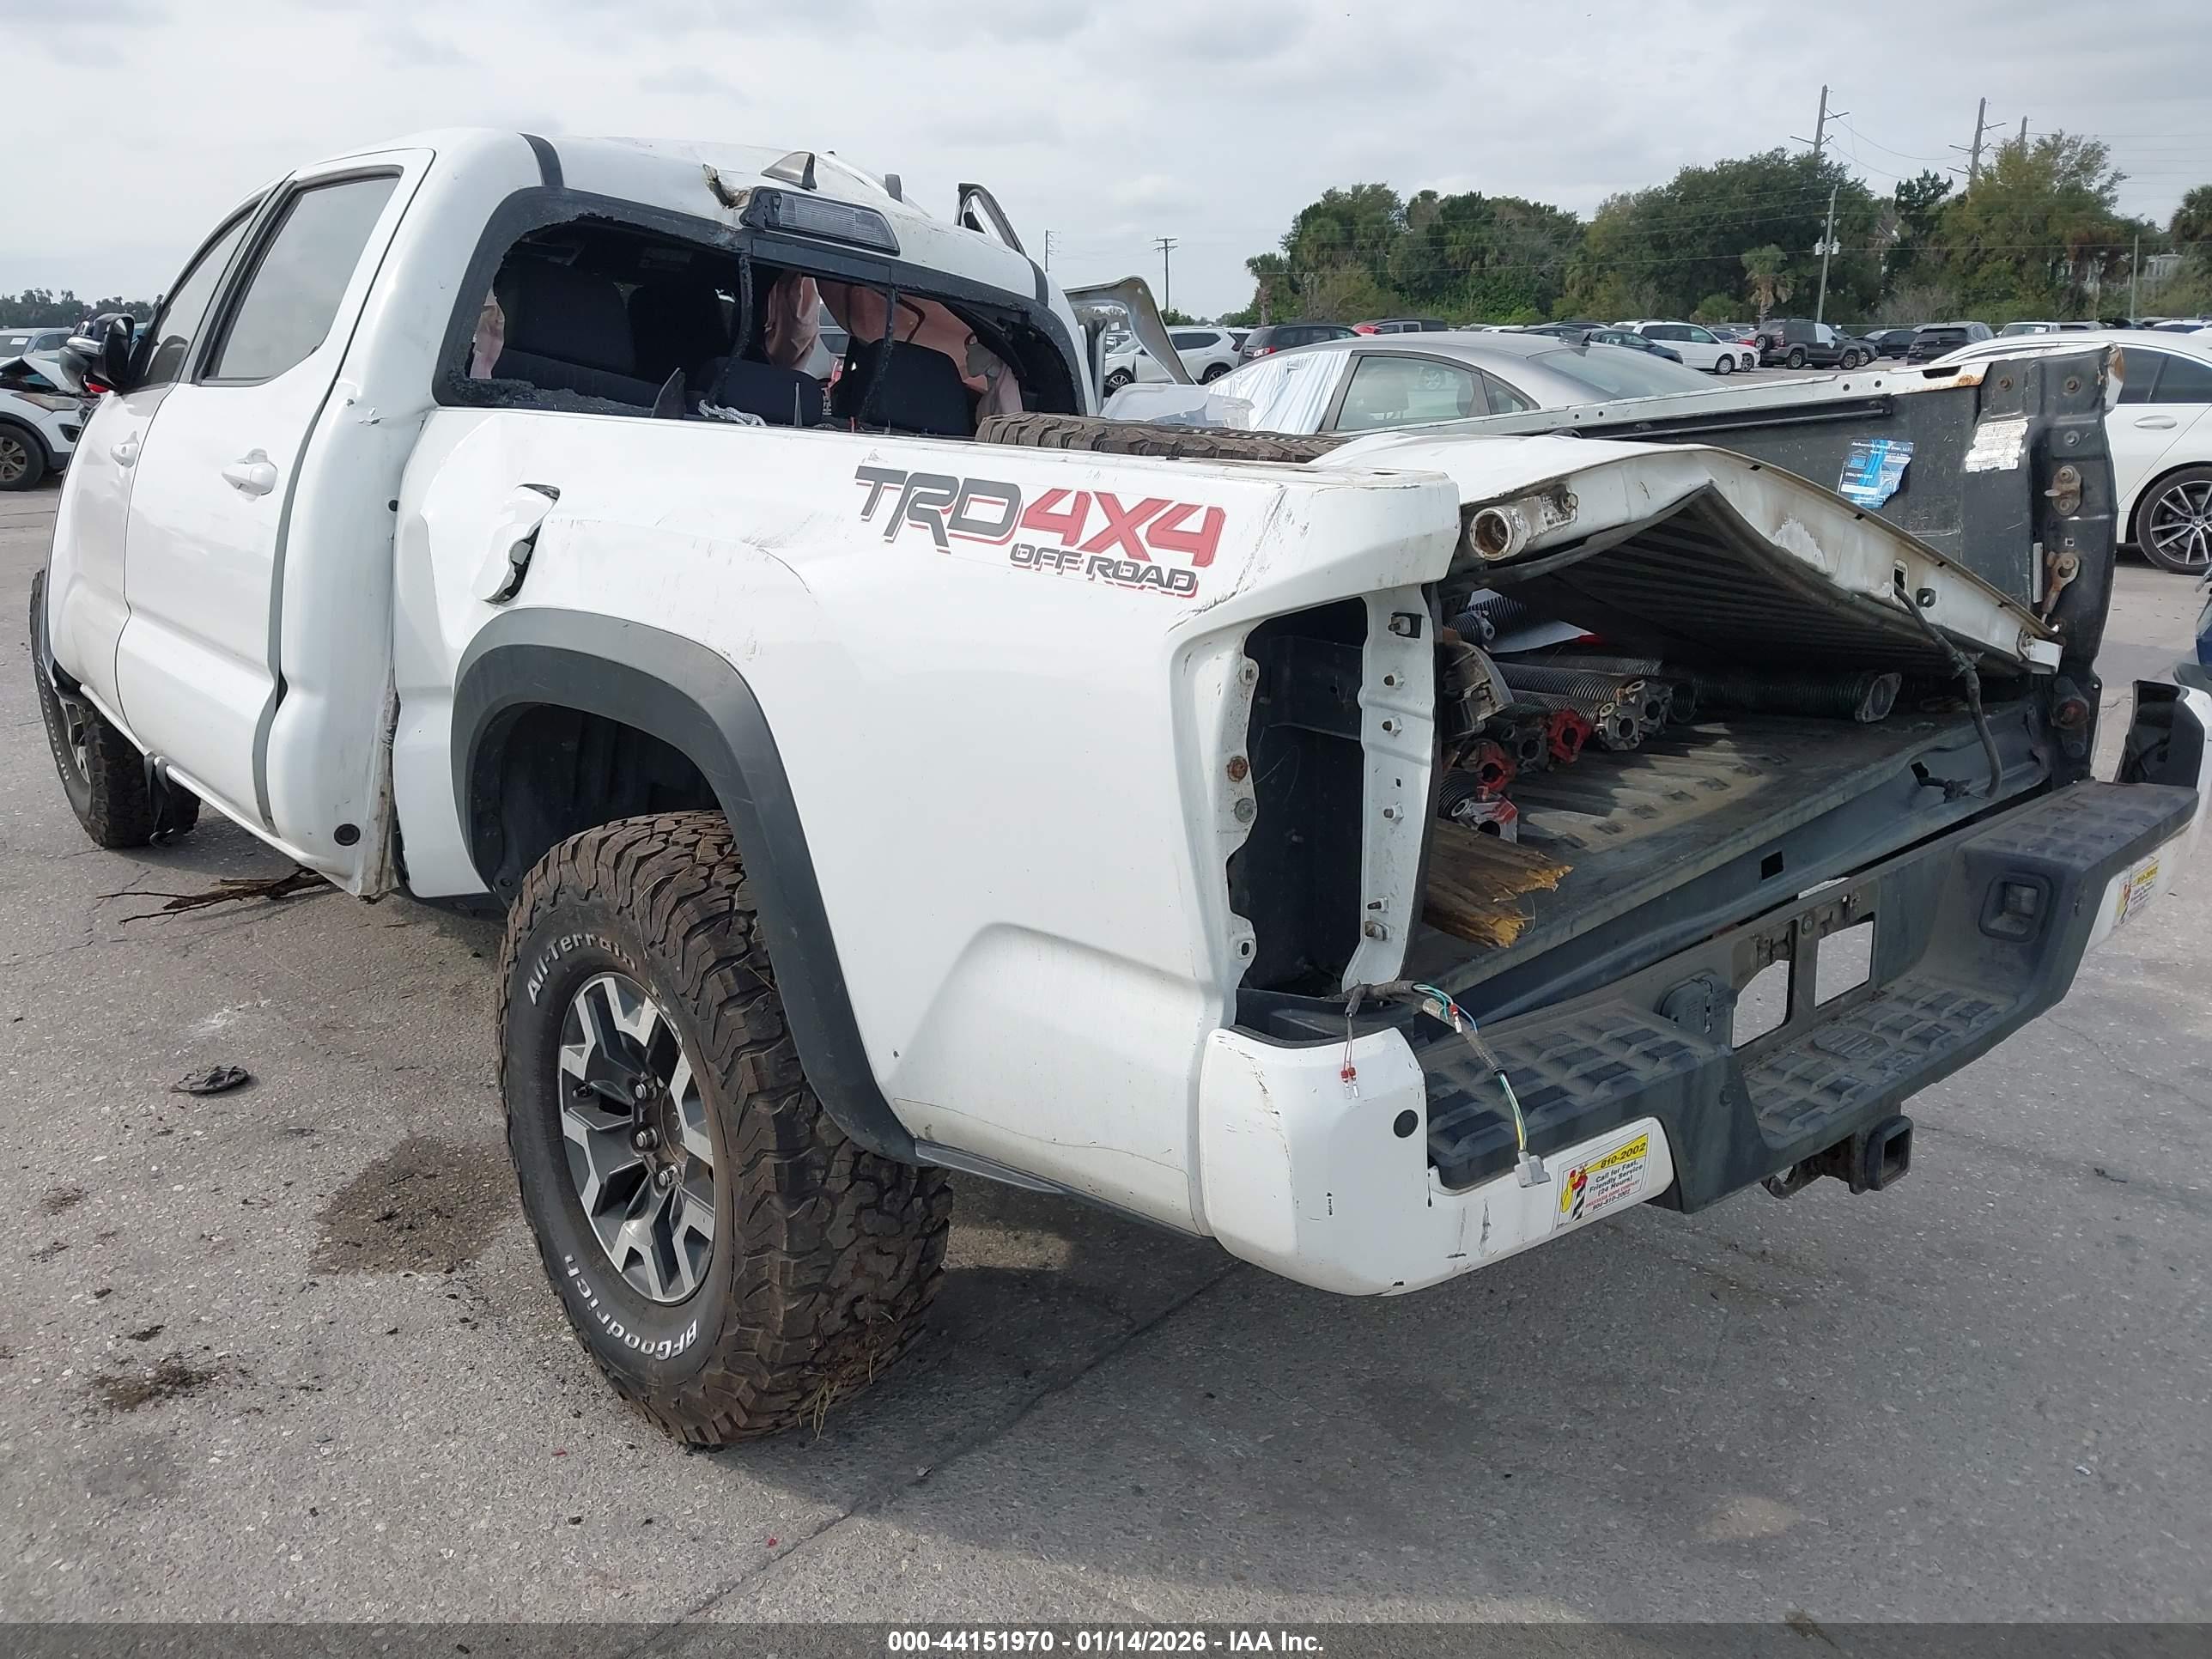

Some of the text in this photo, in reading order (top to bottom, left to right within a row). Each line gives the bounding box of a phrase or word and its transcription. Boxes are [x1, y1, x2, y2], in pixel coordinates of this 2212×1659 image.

[854, 465, 1023, 550] TRD
[1010, 544, 1199, 599] OFF ROAD
[1595, 1159, 1638, 1183] Call for Fast,
[1600, 1142, 1647, 1169] 810-2002
[1589, 1164, 1644, 1194] Friendly Service
[564, 1254, 698, 1361] BFGoodrich
